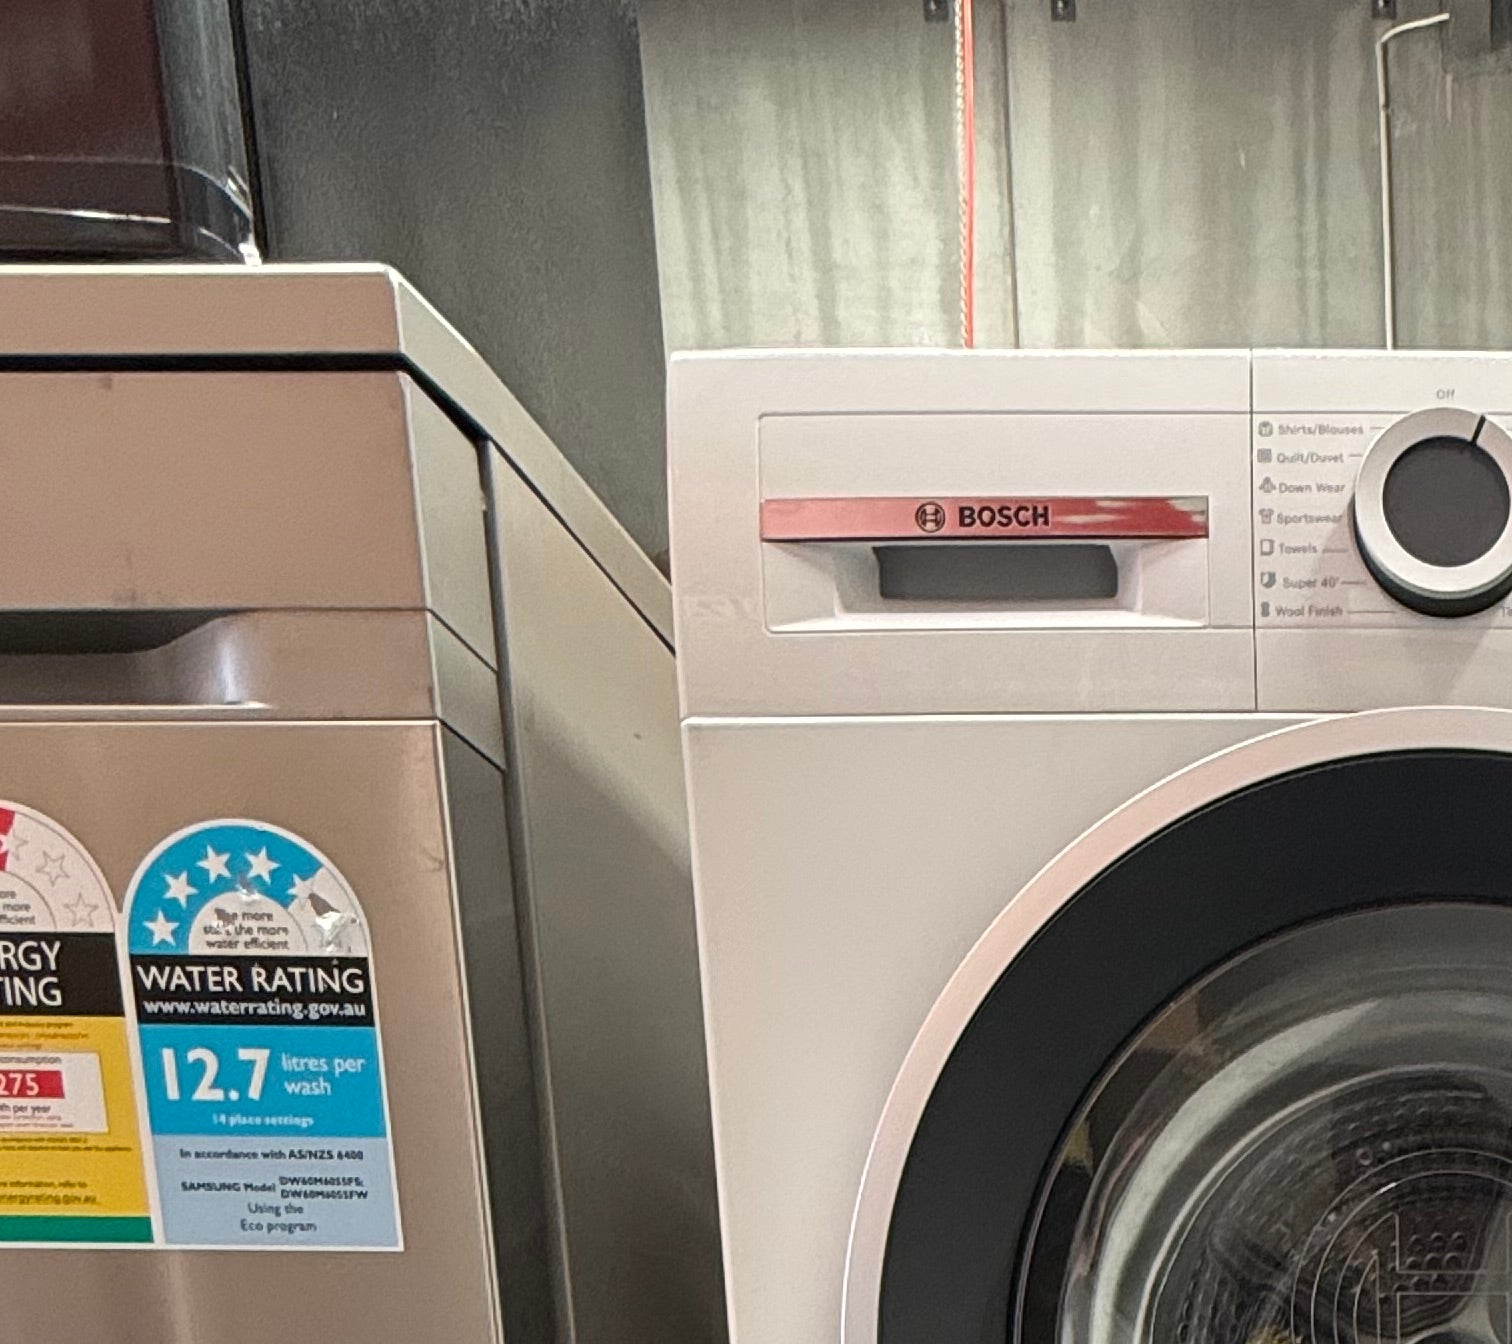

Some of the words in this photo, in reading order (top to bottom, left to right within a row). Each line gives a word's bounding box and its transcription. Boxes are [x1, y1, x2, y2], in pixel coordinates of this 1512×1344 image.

[1436, 390, 1455, 399] Off
[1278, 482, 1312, 493] Down
[1316, 482, 1345, 493] Wear
[959, 504, 1050, 528] BOSCH
[1277, 513, 1344, 525] Sportswear
[1282, 577, 1317, 590] Super
[1308, 606, 1344, 617] Finish
[242, 911, 274, 921] more
[206, 939, 240, 950] water
[136, 965, 243, 993] WATER
[251, 967, 364, 994] RATING
[144, 999, 366, 1020] www.waterrating.gov.au
[281, 1053, 328, 1073] litres
[334, 1058, 366, 1078] per
[161, 1047, 271, 1102] 12.7
[284, 1078, 332, 1096] wash
[240, 1219, 264, 1232] Eco
